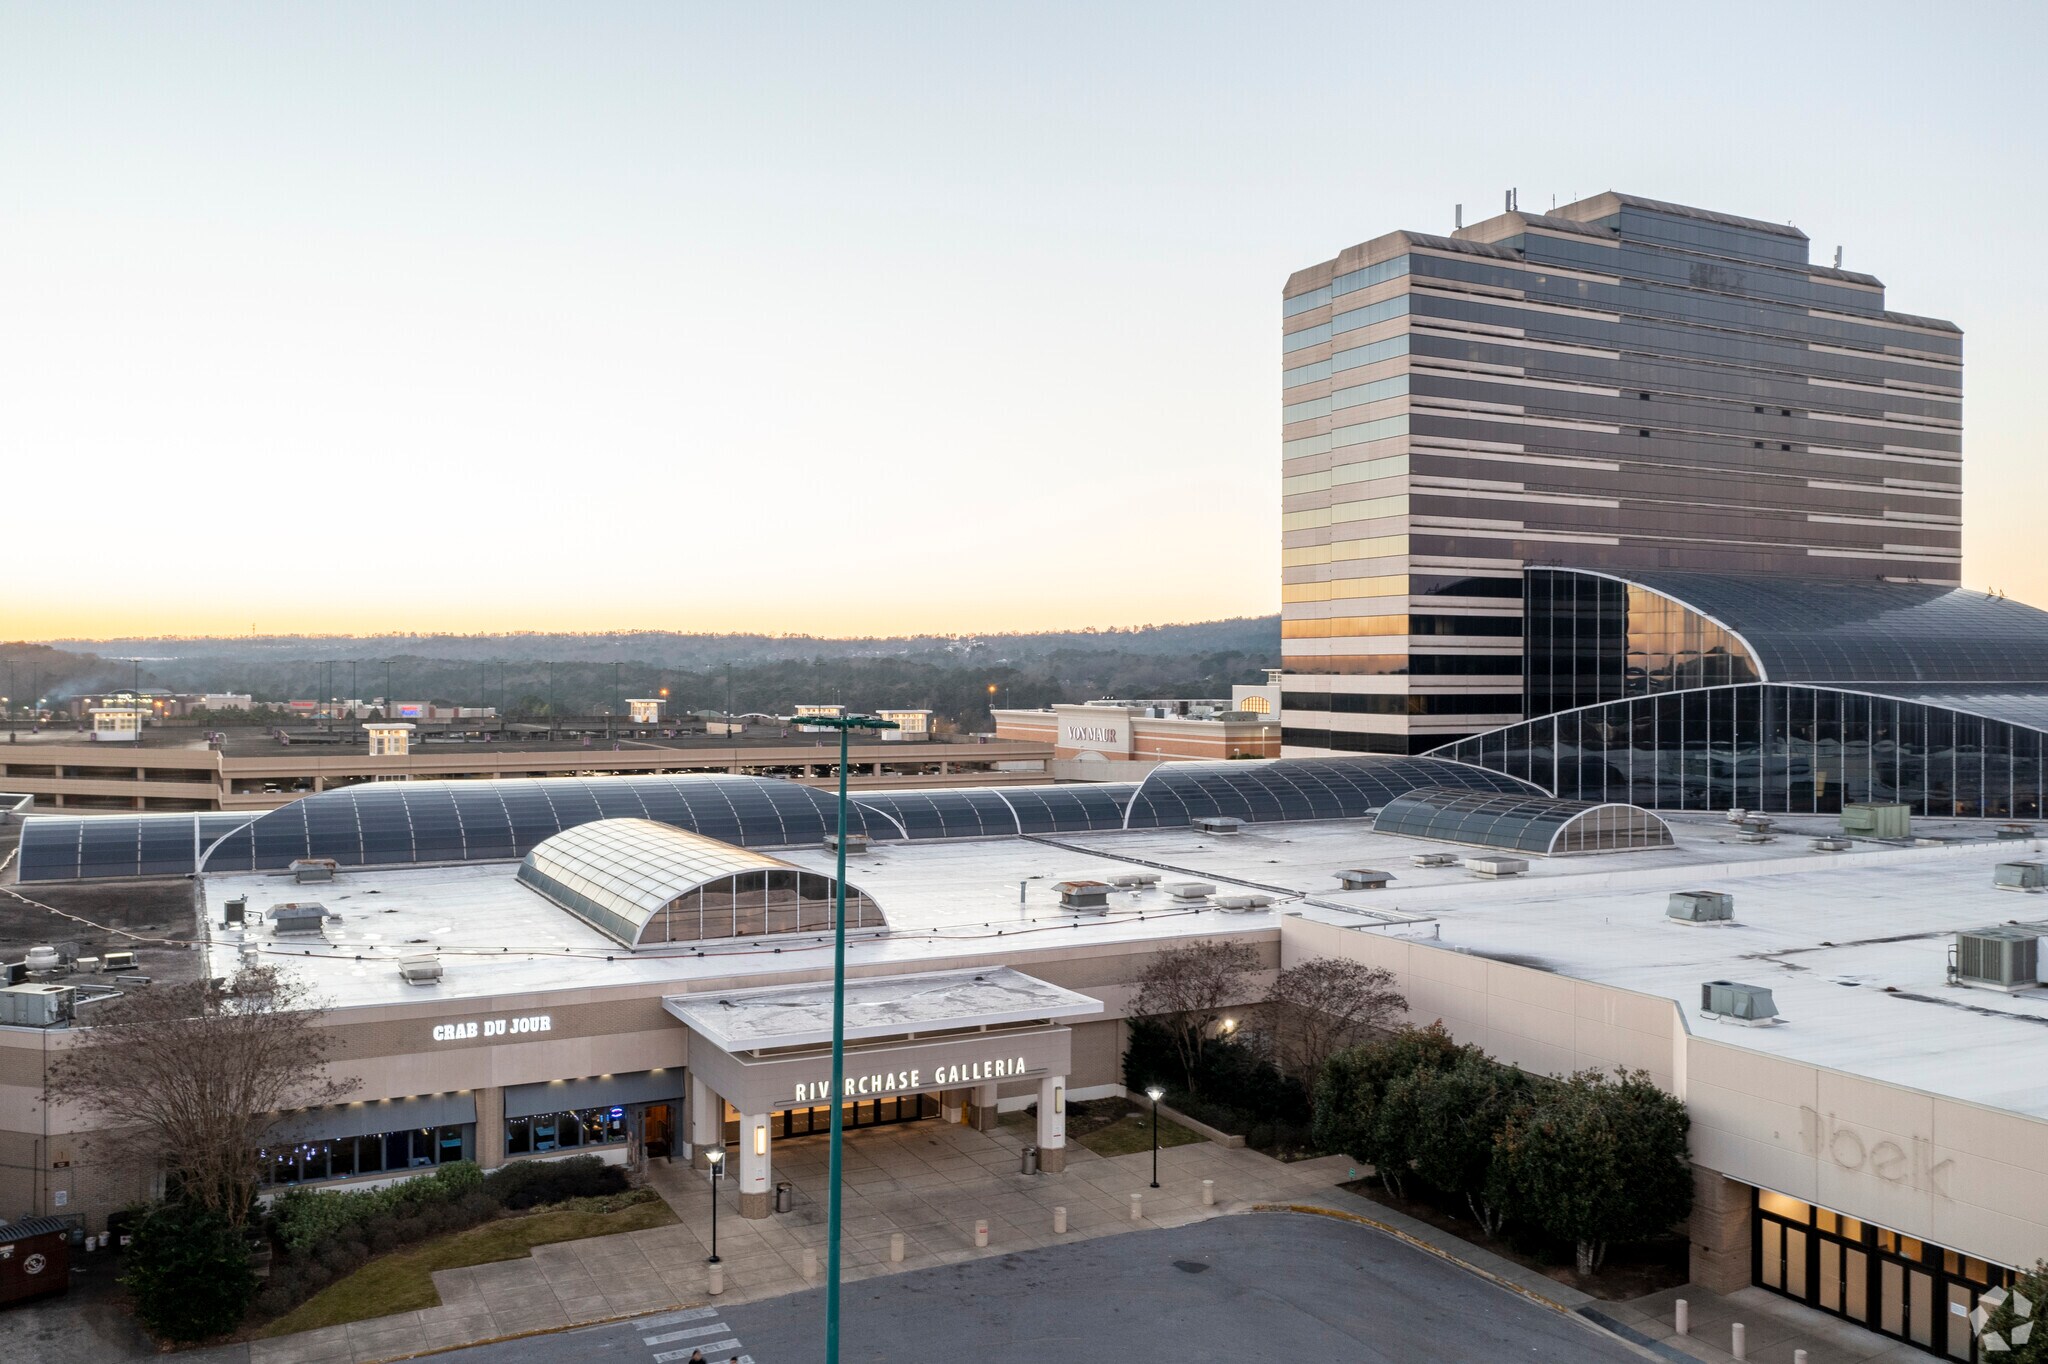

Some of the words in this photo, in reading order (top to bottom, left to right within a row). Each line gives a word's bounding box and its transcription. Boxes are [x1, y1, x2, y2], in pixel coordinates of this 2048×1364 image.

[1068, 726, 1087, 741] VON
[1088, 727, 1117, 743] MAUR
[433, 1022, 479, 1041] CRAB
[483, 1019, 507, 1037] DU
[509, 1015, 552, 1034] JOUR
[795, 1069, 920, 1102] RIVRCHASE
[935, 1056, 1026, 1084] GALLERIA
